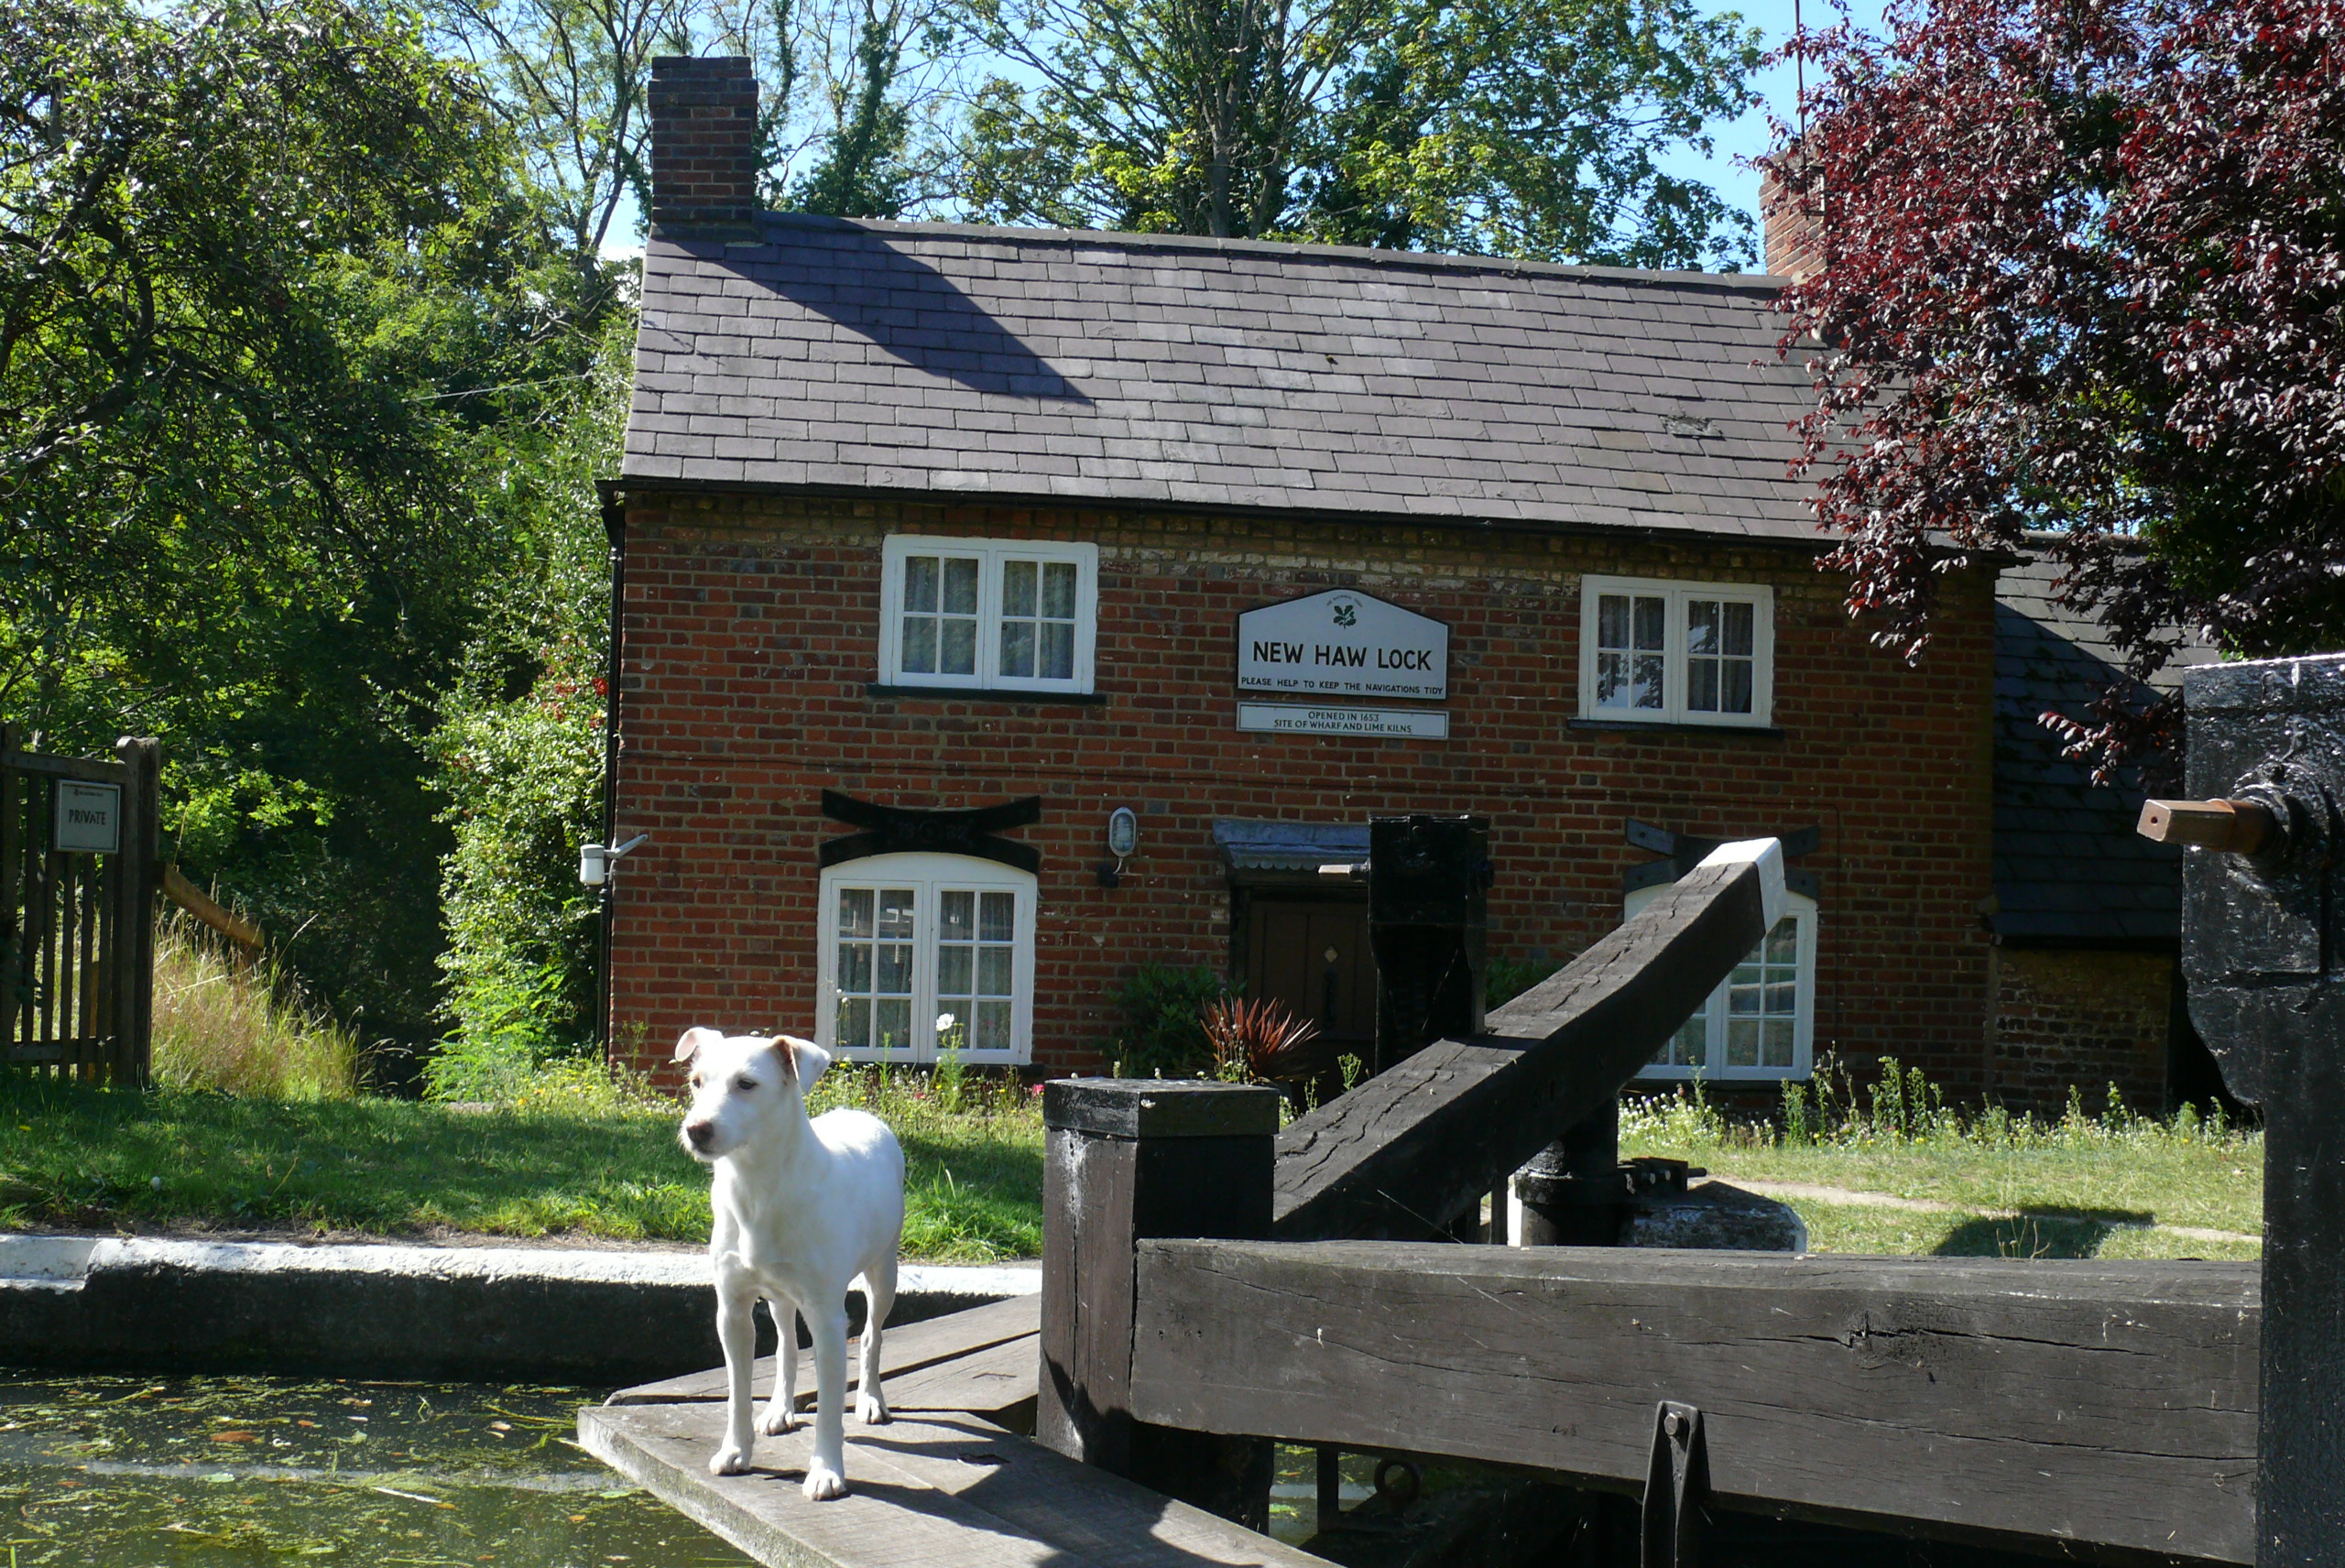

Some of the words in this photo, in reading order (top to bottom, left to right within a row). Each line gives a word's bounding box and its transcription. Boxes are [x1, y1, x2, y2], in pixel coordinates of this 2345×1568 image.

[1253, 641, 1303, 663] NEW
[1314, 645, 1367, 667] HAW
[1378, 648, 1432, 670] LOCK
[1241, 677, 1271, 686] PLEASE
[1345, 682, 1360, 691] THE
[1366, 683, 1420, 693] NAVIGATIONS
[1308, 711, 1345, 720] OPENED
[1347, 713, 1357, 721] IN
[1360, 713, 1380, 722] 1653
[1274, 719, 1292, 727] SITE
[1294, 720, 1307, 728] OF
[1310, 721, 1341, 730] WHARF
[1343, 723, 1362, 731] AND
[1364, 723, 1384, 732] LIME
[1387, 724, 1412, 733] KILNS
[69, 810, 106, 825] PRIVATE
